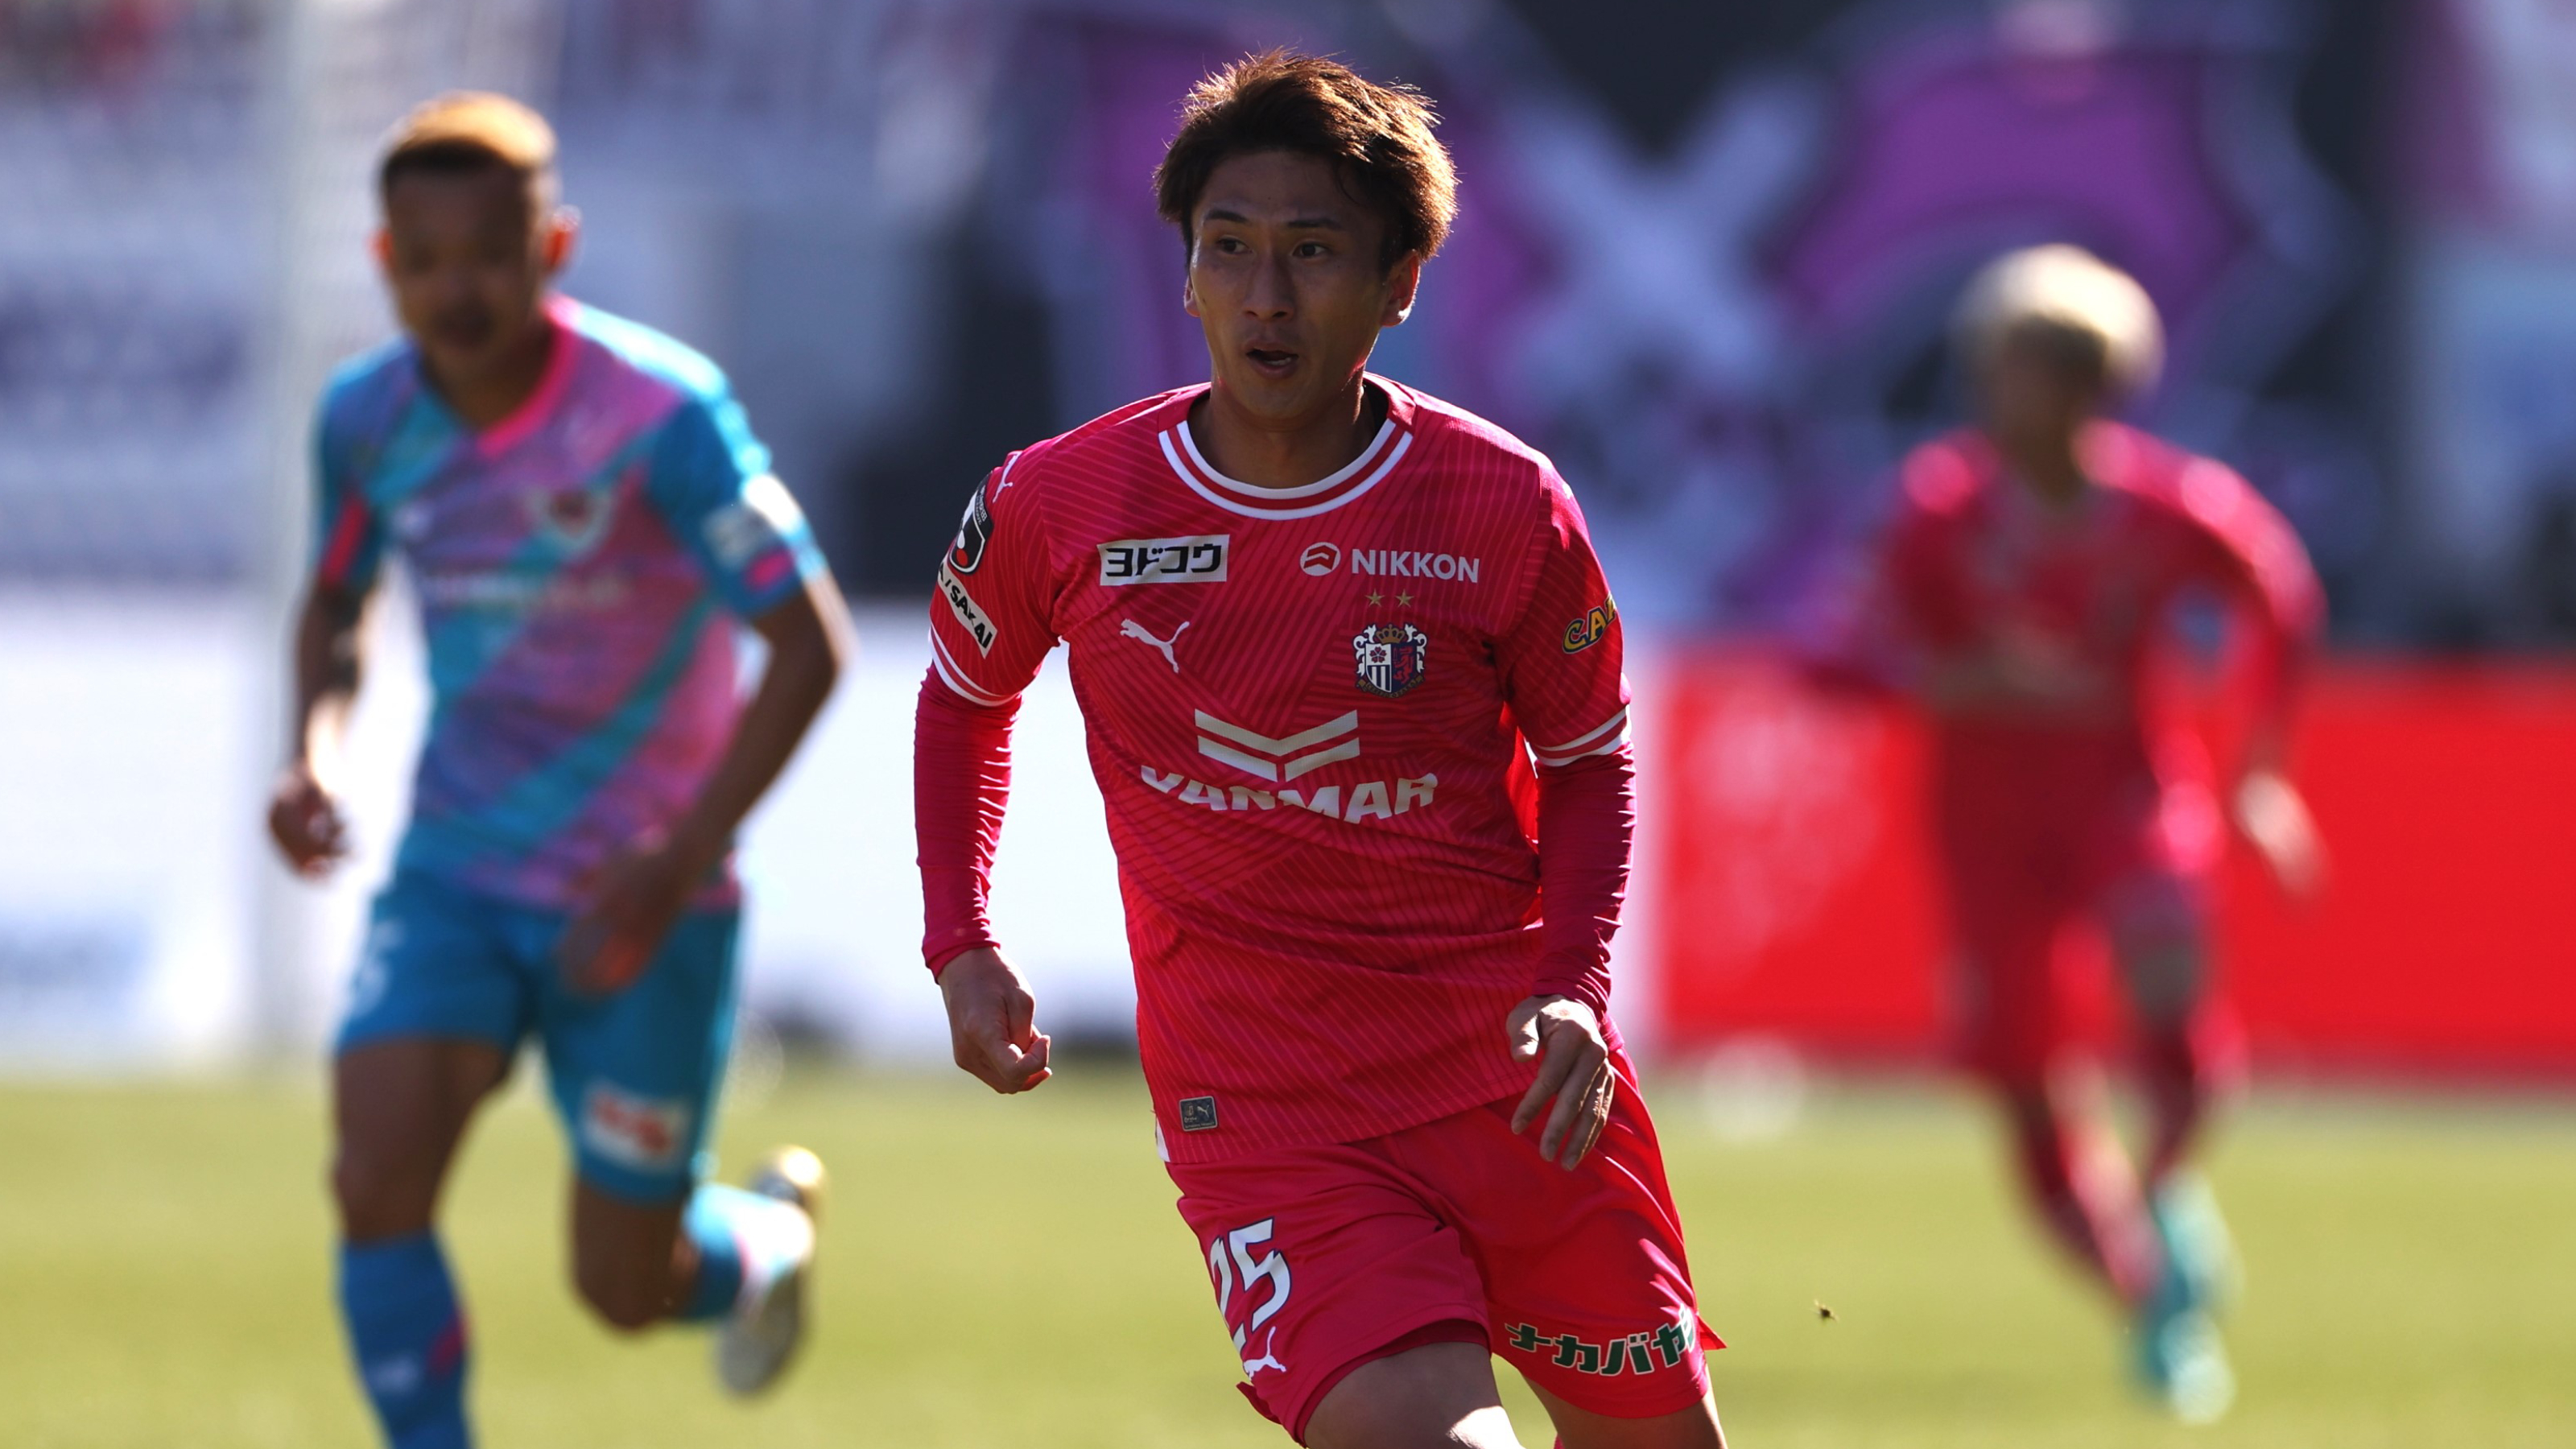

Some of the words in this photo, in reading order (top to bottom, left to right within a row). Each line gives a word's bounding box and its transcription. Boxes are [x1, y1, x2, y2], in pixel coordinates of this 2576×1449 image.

[1104, 542, 1223, 578] ヨドコウ
[1351, 548, 1480, 584] NIKKON
[1209, 1216, 1292, 1357] 25
